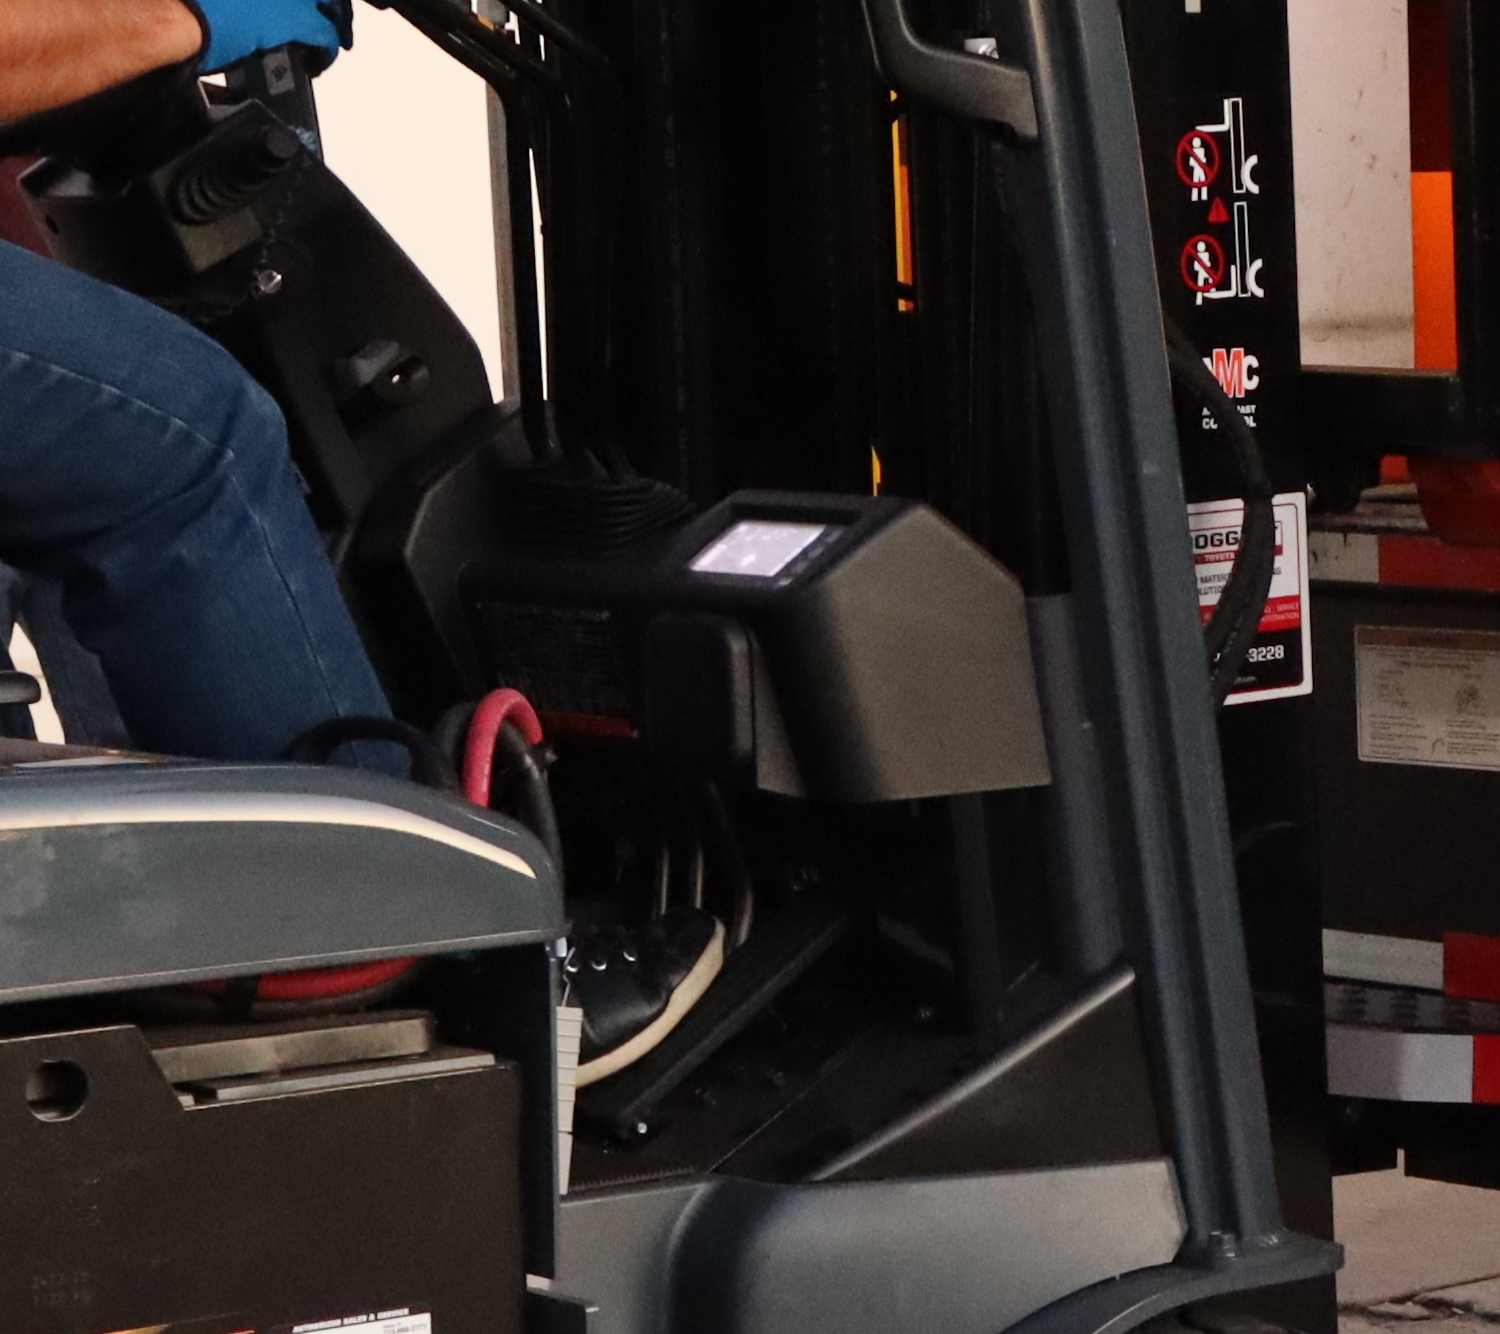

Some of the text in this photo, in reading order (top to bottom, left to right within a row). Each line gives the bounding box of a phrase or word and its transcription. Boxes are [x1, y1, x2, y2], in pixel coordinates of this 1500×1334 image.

[342, 1314, 368, 1326] SALES
[368, 1313, 376, 1322] &
[377, 1307, 410, 1320] SERVICE
